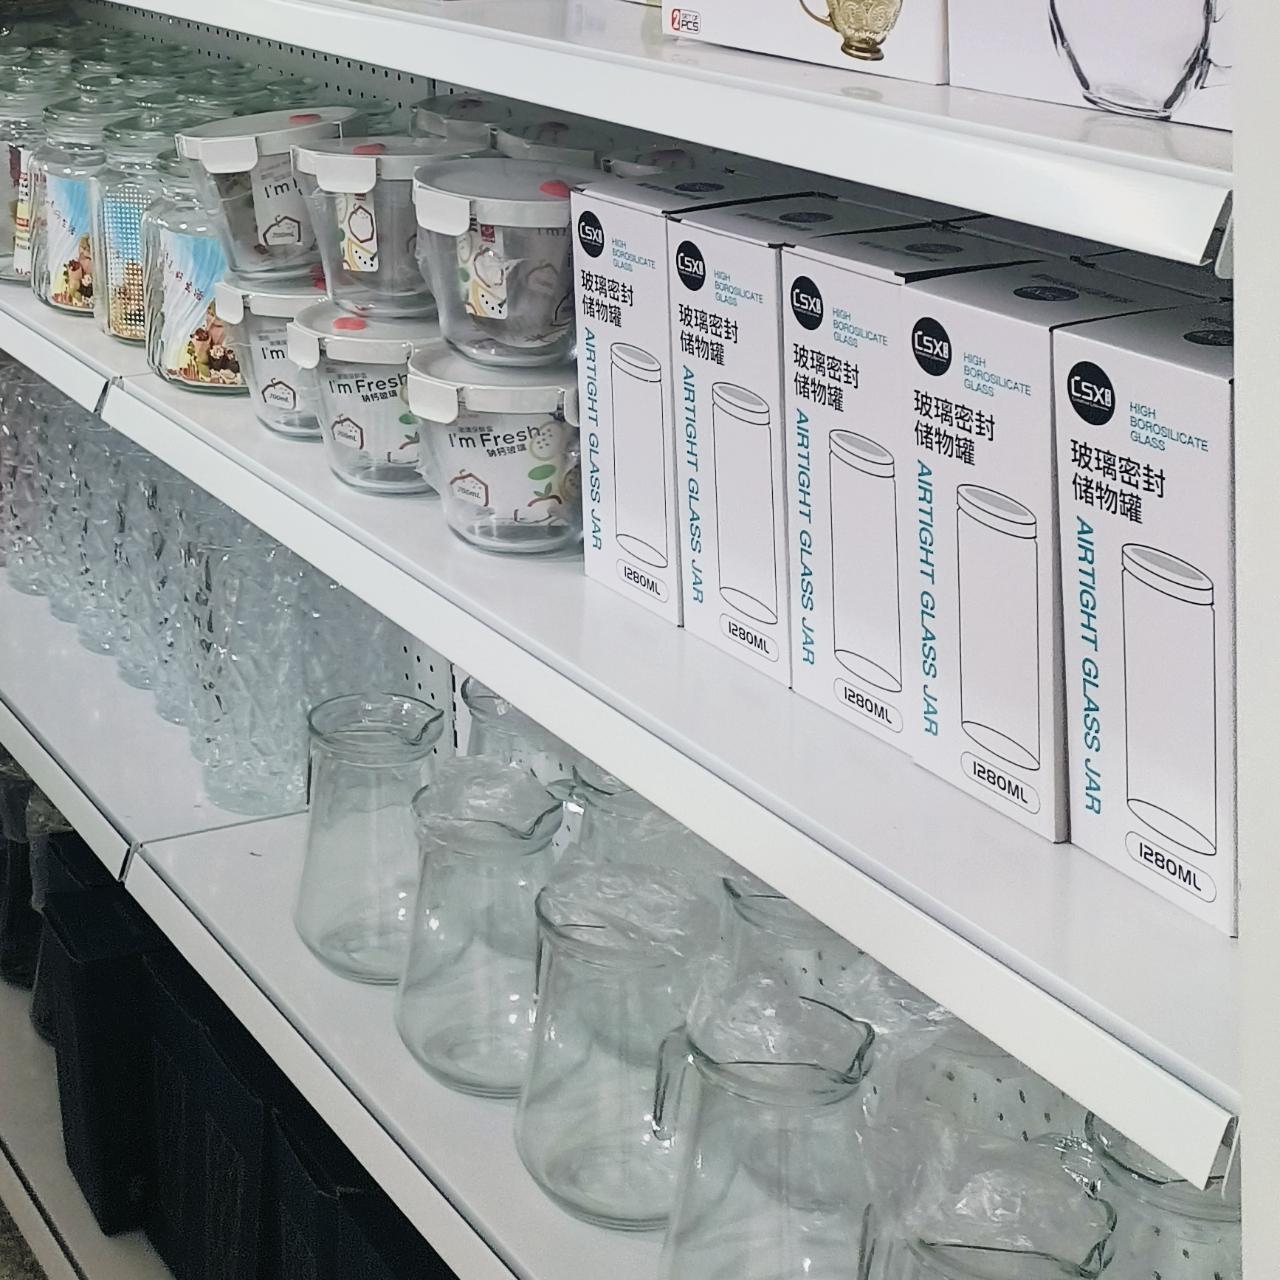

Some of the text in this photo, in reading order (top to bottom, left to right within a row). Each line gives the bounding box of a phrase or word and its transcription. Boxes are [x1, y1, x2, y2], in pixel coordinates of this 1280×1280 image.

[672, 9, 681, 30] 2
[681, 21, 699, 32] PCS
[264, 183, 290, 198] I'm
[611, 238, 627, 248] HIGH
[612, 248, 656, 269] BOROSILICATE
[613, 259, 633, 272] GLASS
[713, 270, 730, 282] HIGH
[581, 269, 634, 307] 玻璃密封
[714, 280, 763, 304] BOROSILICATE
[715, 292, 738, 307] GLASS
[582, 293, 622, 328] 储物罐
[679, 303, 738, 344] 玻璃密封
[832, 307, 851, 322] HIGH
[680, 329, 725, 366] 储物罐
[832, 319, 888, 346] BOROSILICATE
[833, 332, 859, 348] GLASS
[261, 347, 286, 360] I'm
[793, 343, 860, 390] 玻璃密封
[963, 352, 986, 368] HIGH
[328, 380, 353, 394] I'm
[355, 373, 408, 393] Fresh
[794, 371, 844, 413] 储物罐
[963, 365, 1032, 396] BOROSILICATE
[963, 380, 994, 397] GLASS
[913, 389, 996, 442] 玻璃密封
[1129, 402, 1157, 419] HIGH
[448, 426, 541, 449] I'm Fresh
[584, 327, 602, 551] AIRTIGHT GLASS JAR
[914, 419, 976, 467] 储物罐
[1129, 415, 1209, 452] BOROSILICATE
[1130, 430, 1166, 451] GLASS
[1070, 438, 1166, 498] 玻璃密封
[682, 365, 704, 604] AIRTIGHT GLASS JAR
[1072, 472, 1143, 524] 储物罐
[796, 408, 815, 665] AIRTIGHT GLASS JAR
[623, 566, 661, 596] 1280ML
[917, 459, 939, 737] AIRTIGHT GLASS JAR
[728, 620, 770, 656] 1280ML
[1076, 515, 1102, 815] AIRTIGHT GLASS JAR
[843, 686, 892, 724] 1280ML
[972, 761, 1028, 805] 1280ML
[1139, 841, 1201, 893] 1280ML
